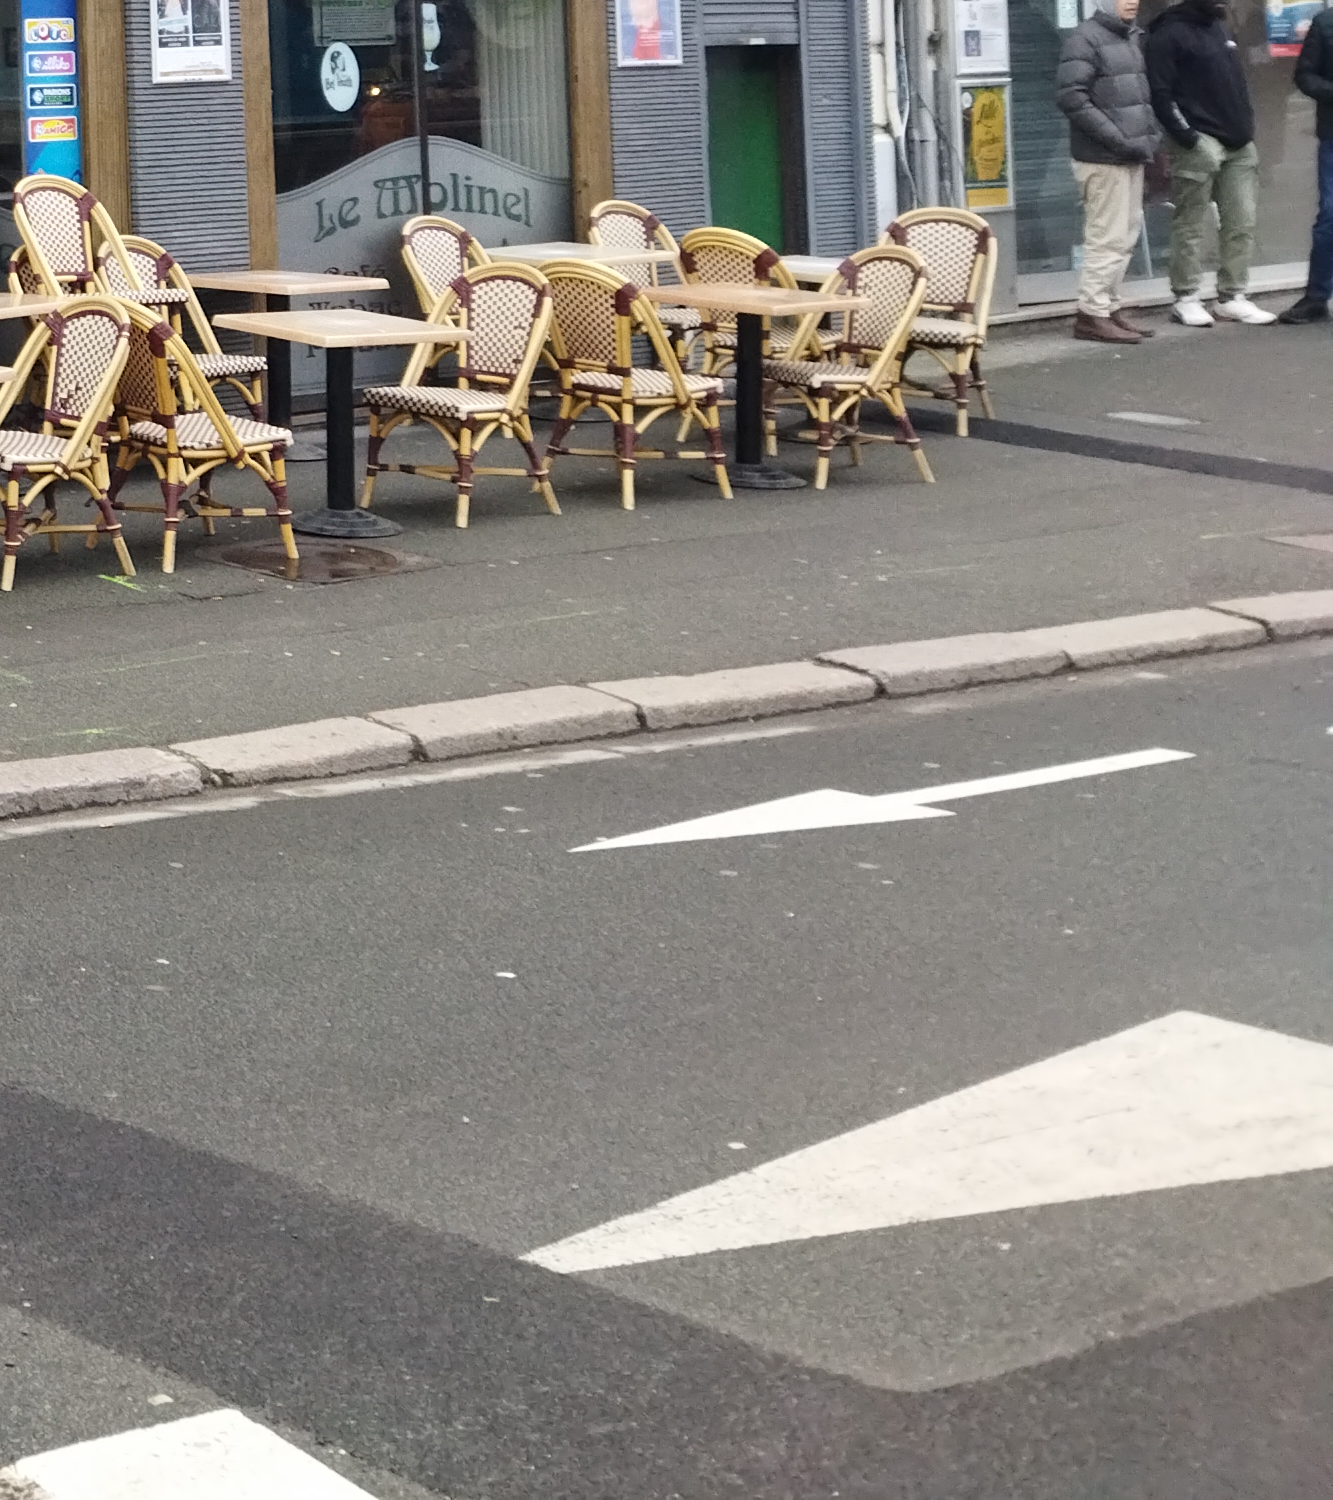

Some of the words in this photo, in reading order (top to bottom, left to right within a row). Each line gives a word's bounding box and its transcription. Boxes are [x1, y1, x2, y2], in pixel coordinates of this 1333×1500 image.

[30, 22, 69, 42] LOTO
[314, 196, 361, 243] Le
[373, 172, 533, 228] Molinel
